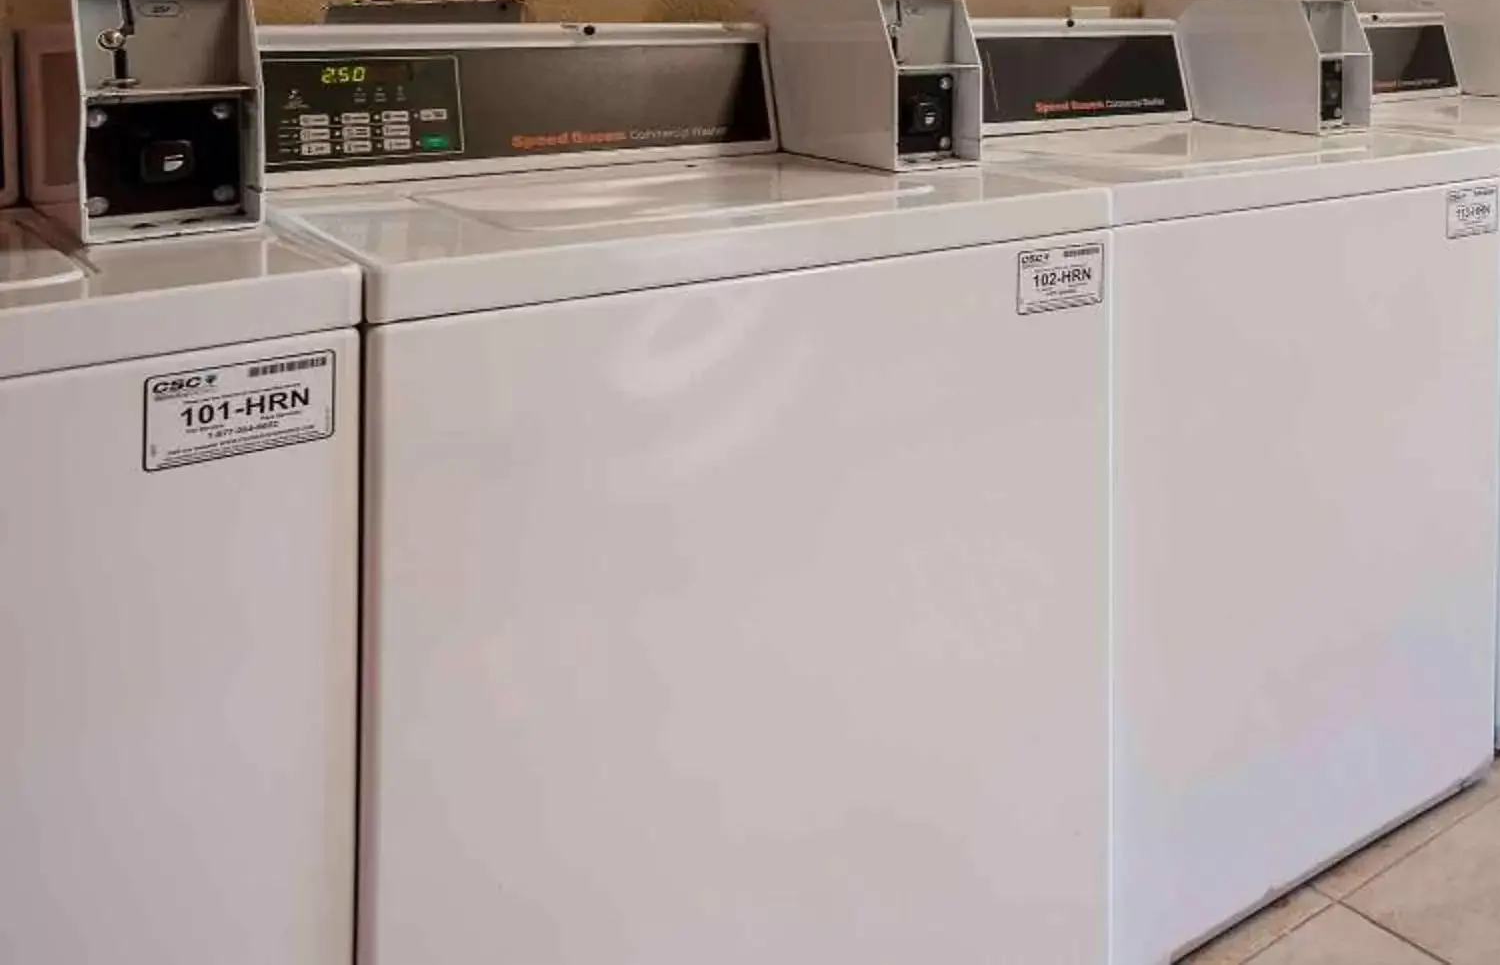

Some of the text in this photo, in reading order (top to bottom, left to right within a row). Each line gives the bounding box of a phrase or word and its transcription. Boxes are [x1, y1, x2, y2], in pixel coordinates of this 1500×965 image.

[1033, 267, 1092, 287] 102-HRN
[152, 376, 201, 393] CSC
[180, 387, 310, 427] 101-HRN
